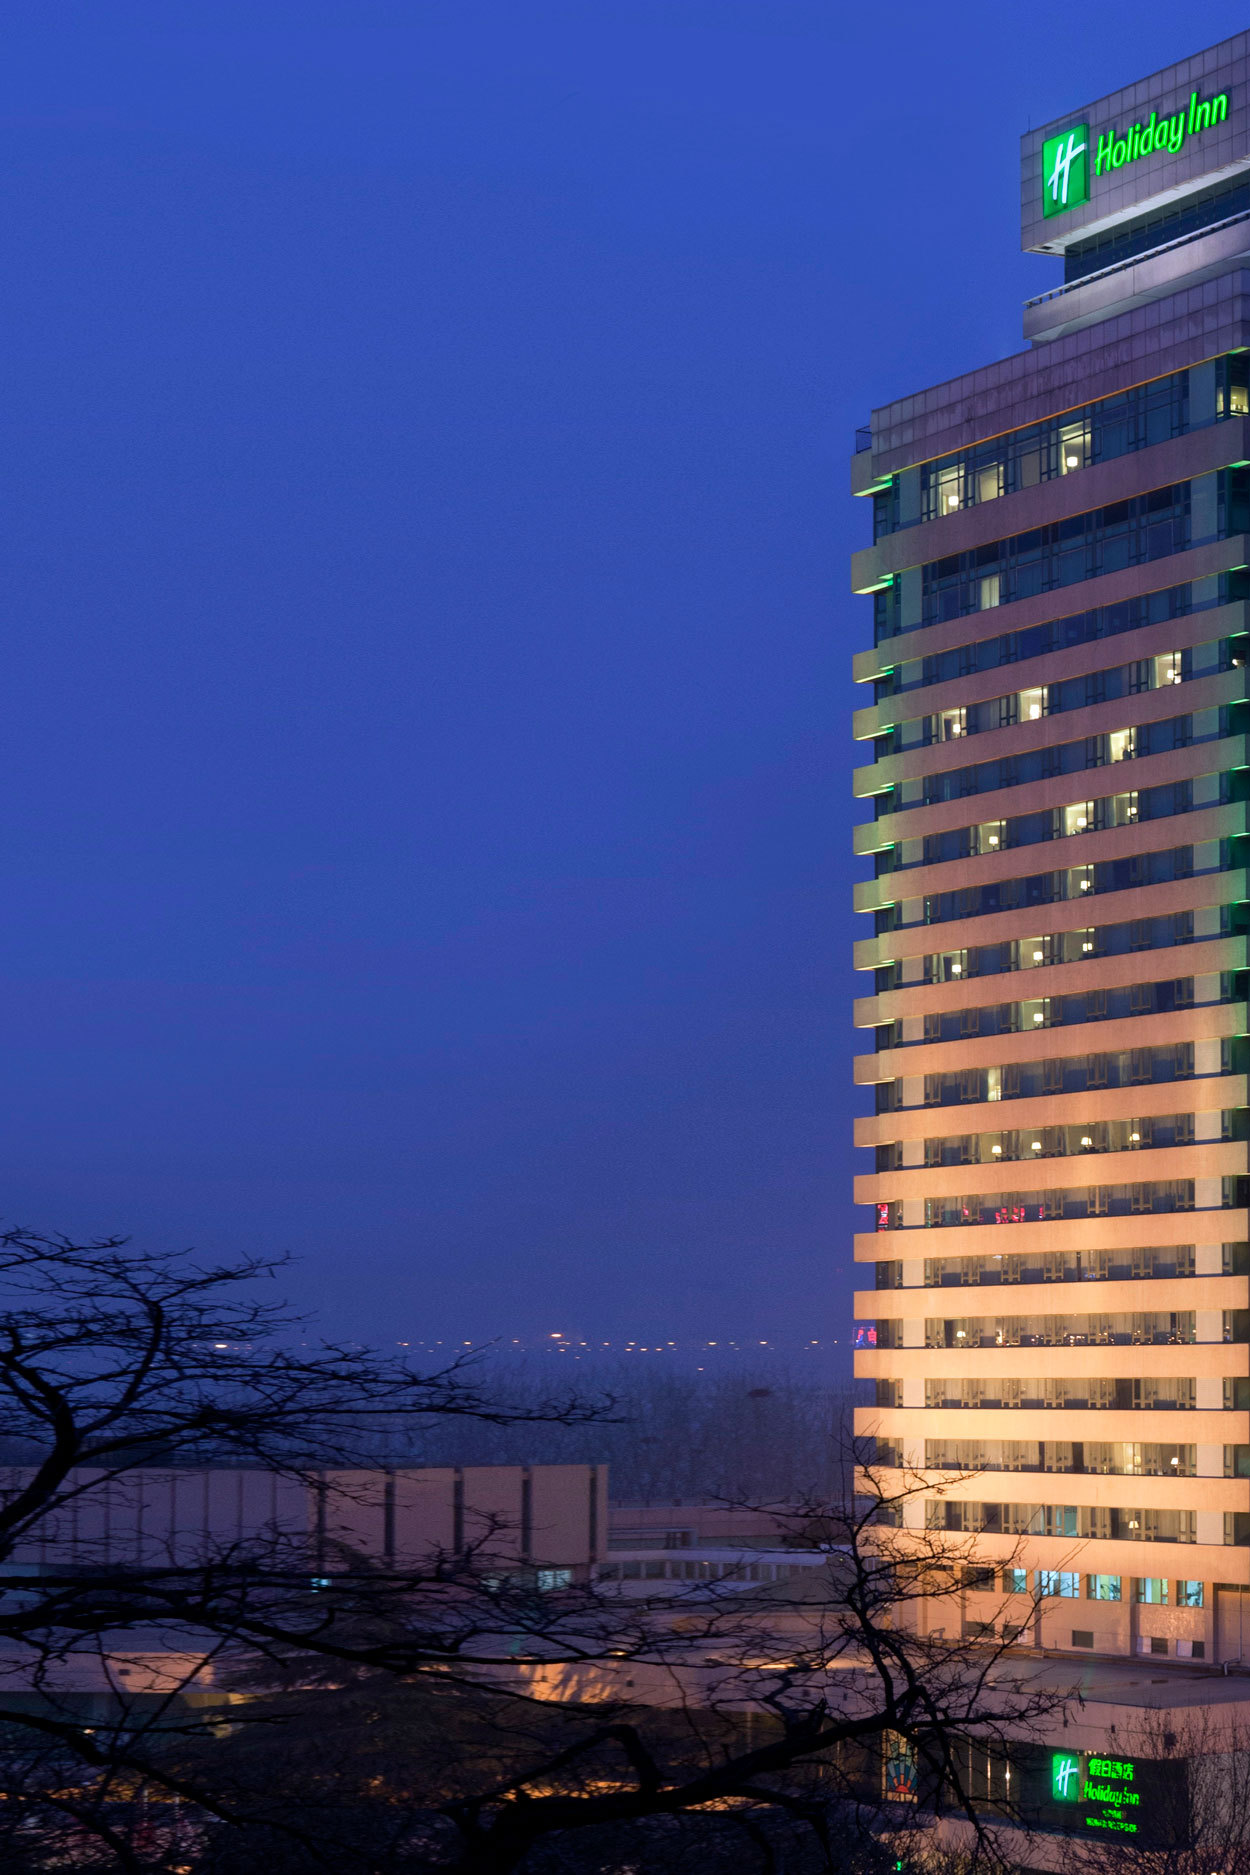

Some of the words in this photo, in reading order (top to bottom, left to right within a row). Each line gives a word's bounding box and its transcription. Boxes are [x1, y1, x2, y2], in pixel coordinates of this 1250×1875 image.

[1094, 111, 1186, 176] Holiday
[1187, 92, 1228, 135] Inn
[1088, 1758, 1134, 1781] 假日酒店
[1083, 1780, 1124, 1808] Holiday
